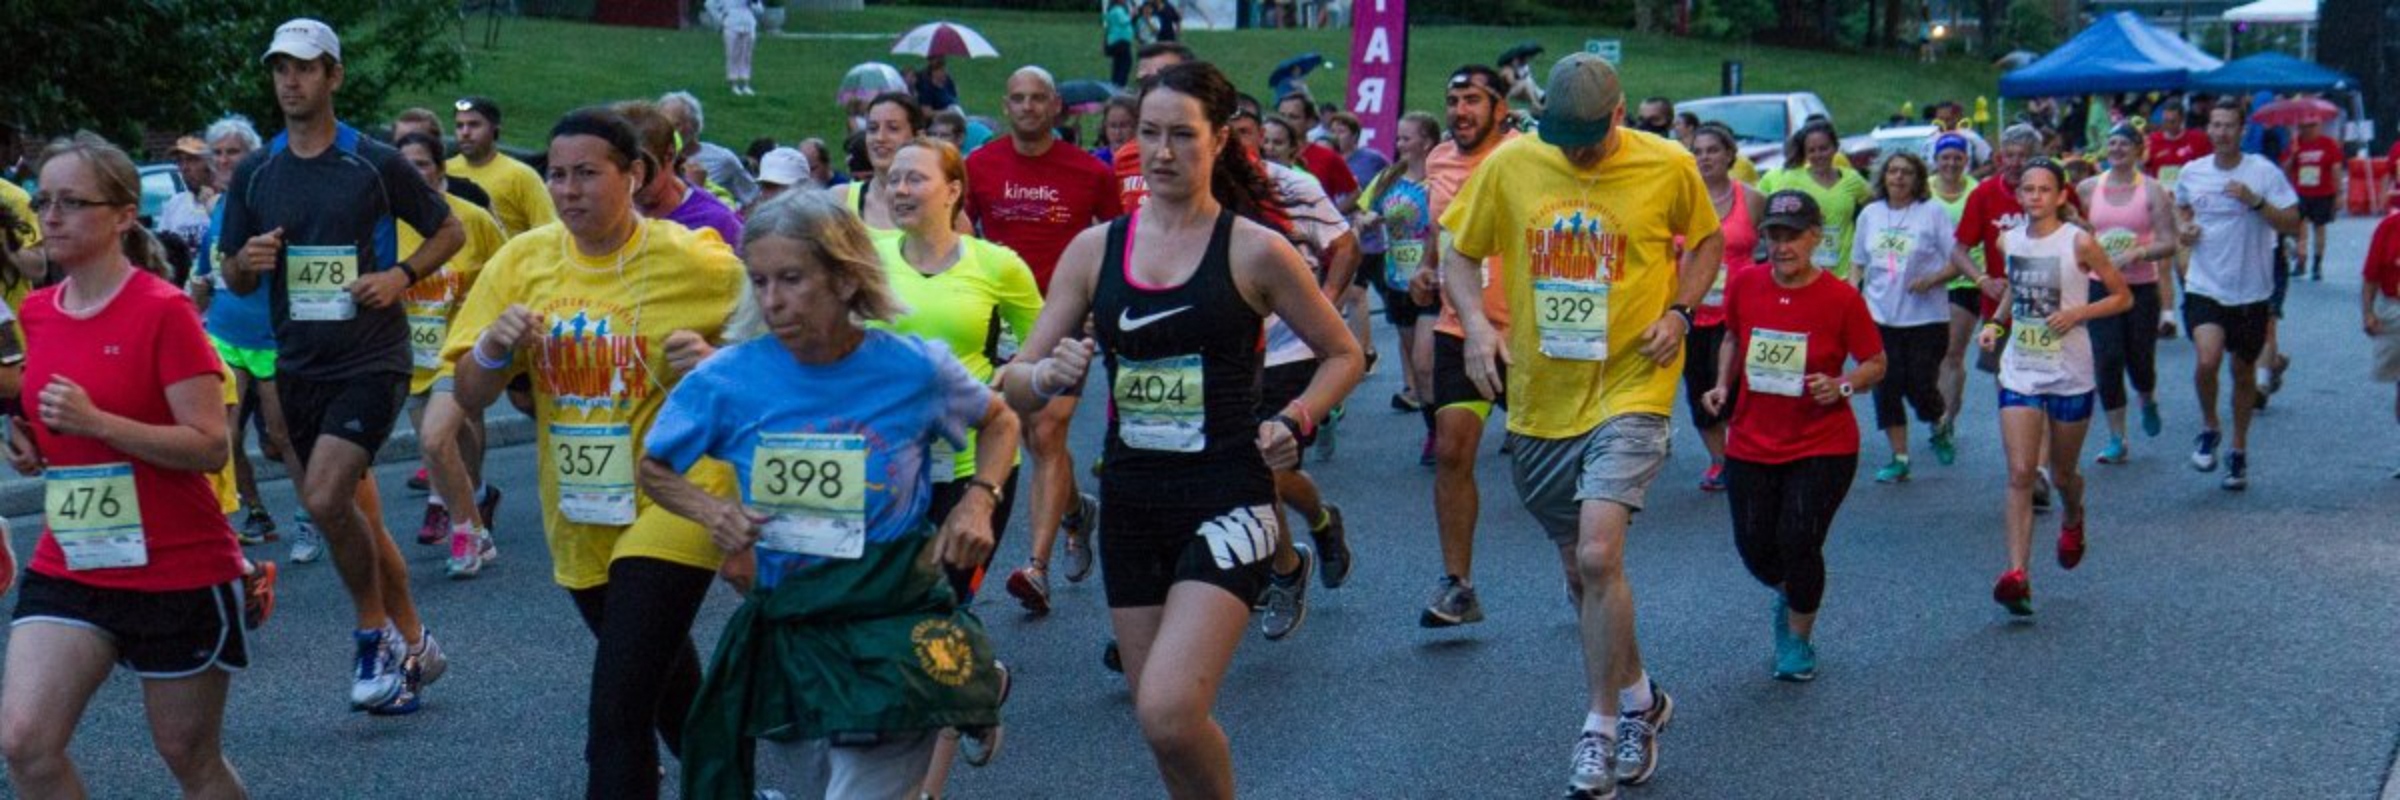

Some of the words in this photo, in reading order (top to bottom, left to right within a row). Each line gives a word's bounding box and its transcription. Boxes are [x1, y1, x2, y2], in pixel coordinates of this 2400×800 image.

[1004, 181, 1060, 202] kinetic
[298, 261, 345, 285] 478
[1545, 297, 1595, 323] 329
[412, 326, 438, 344] 66
[2018, 328, 2051, 347] 416
[1755, 341, 1796, 364] 367
[1126, 374, 1187, 405] 404
[558, 443, 615, 476] 357
[765, 457, 843, 499] 398
[59, 485, 121, 520] 476
